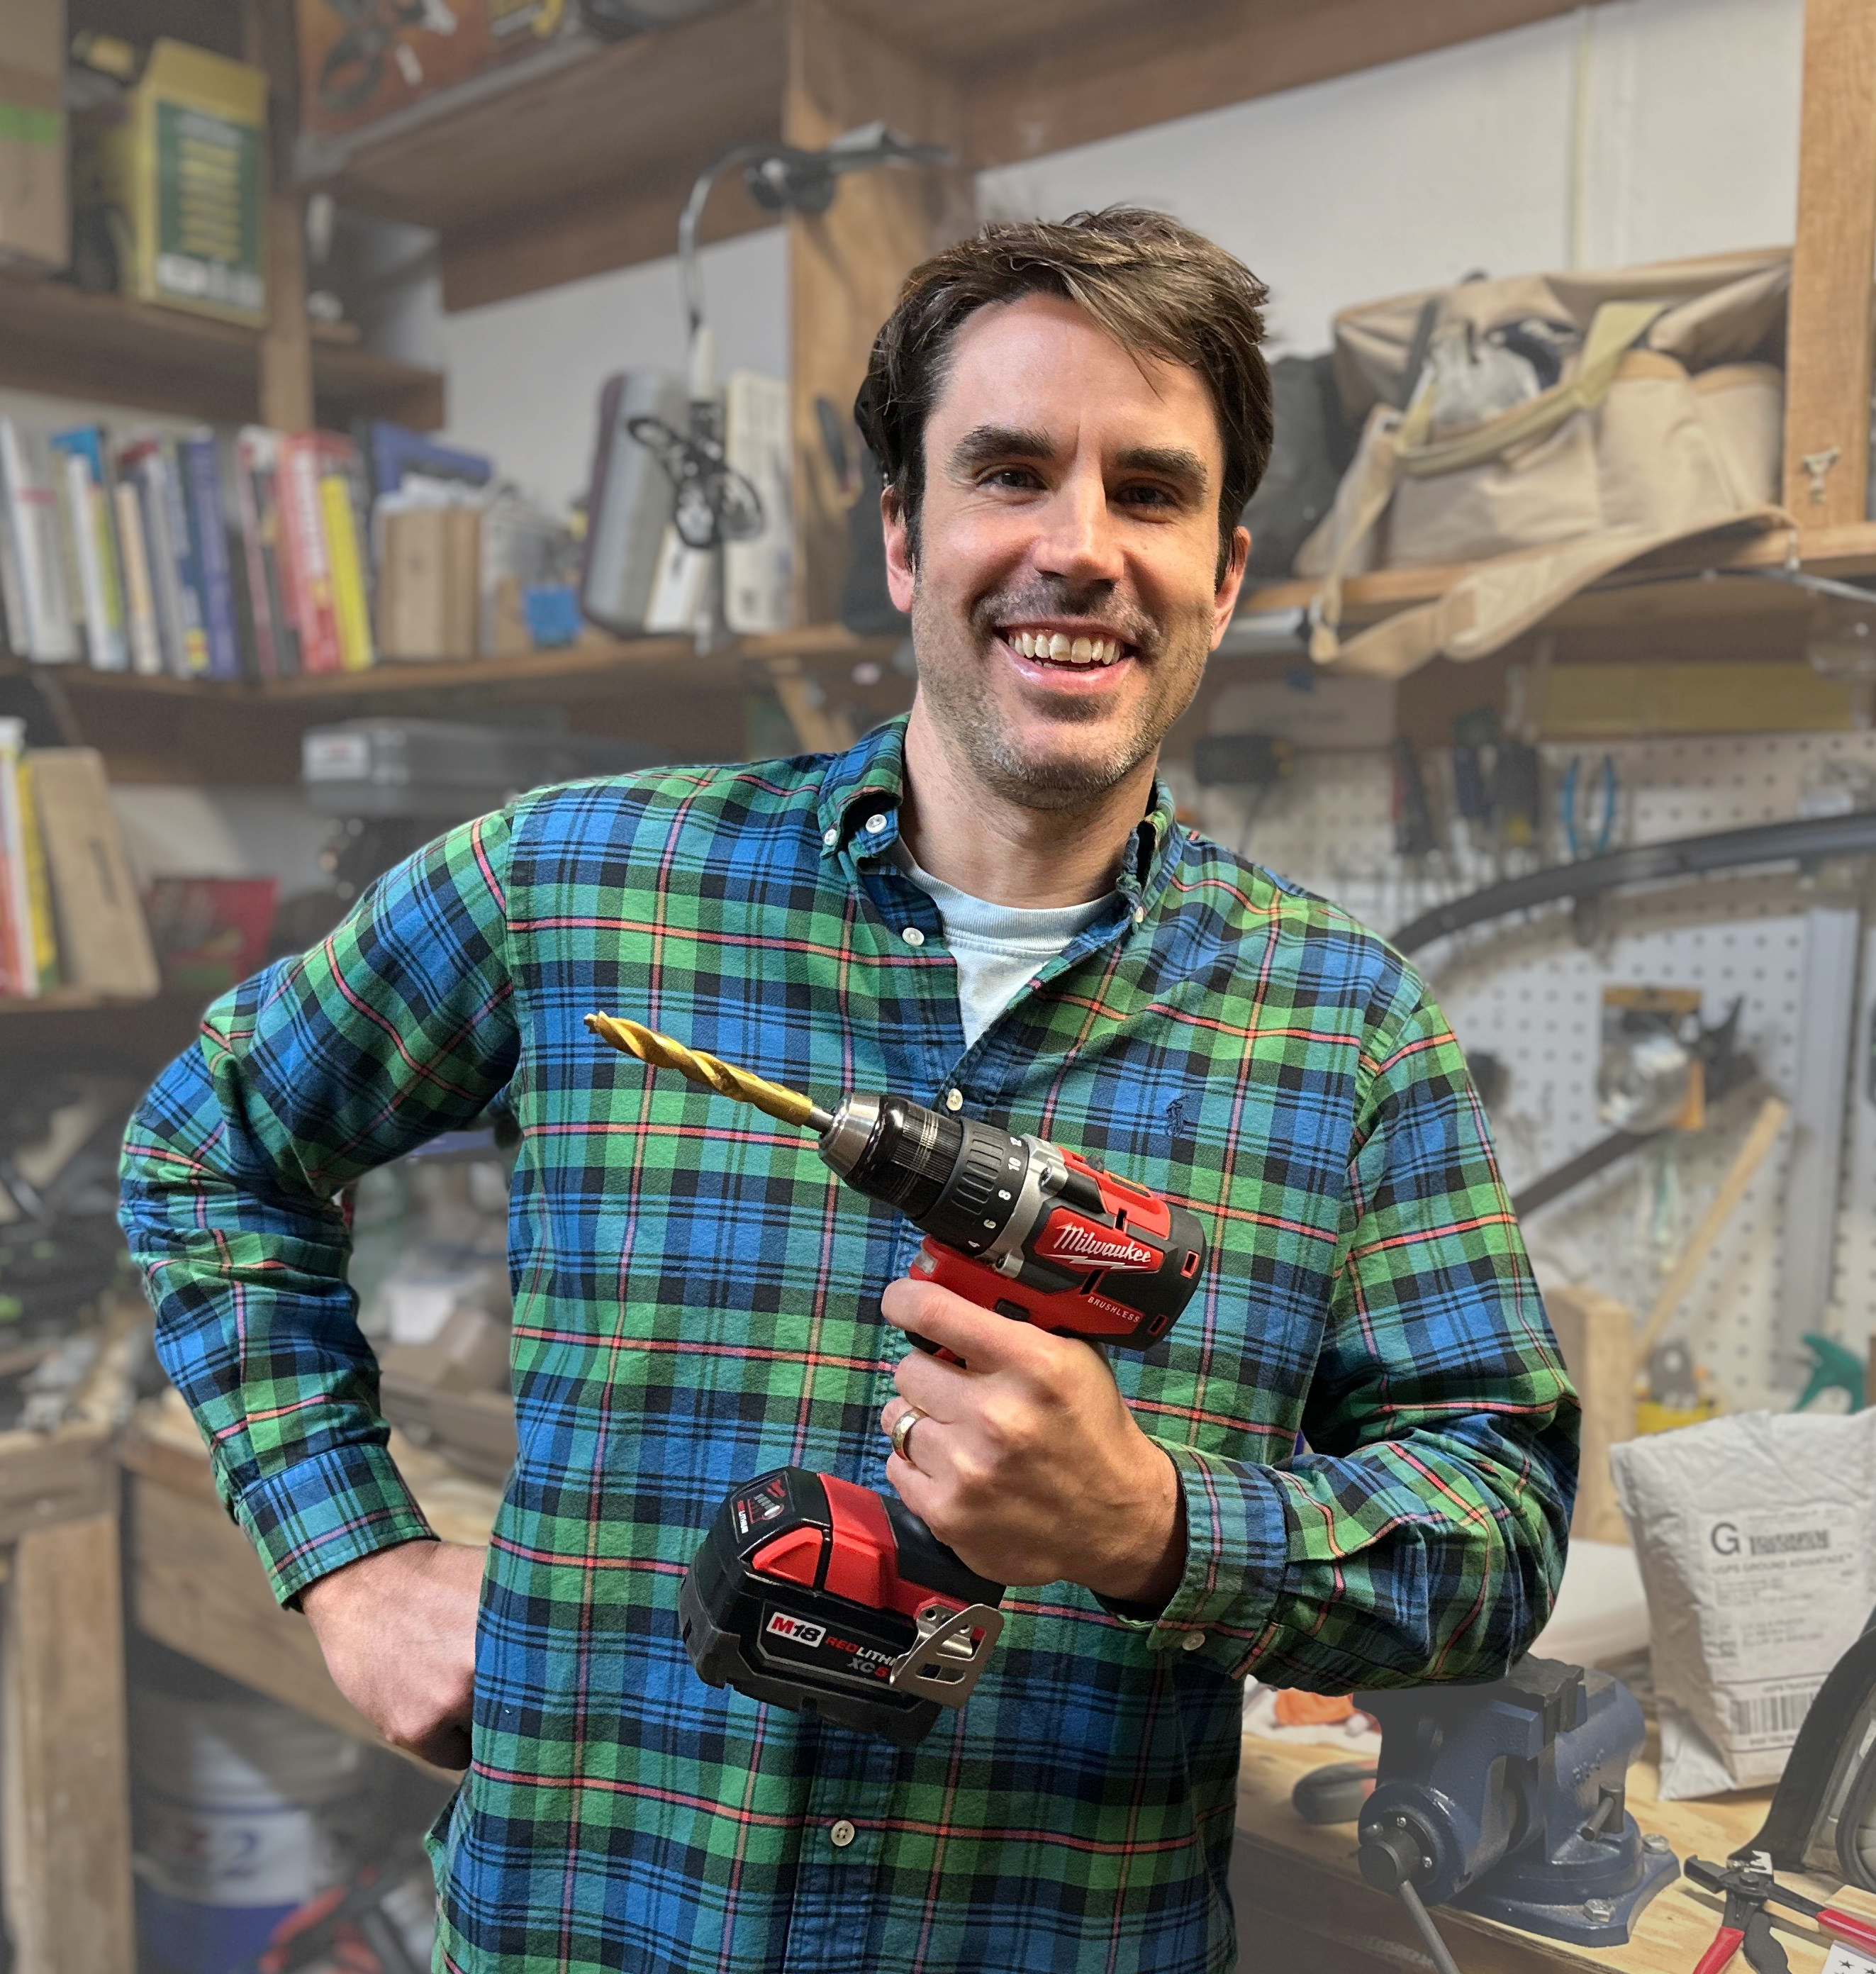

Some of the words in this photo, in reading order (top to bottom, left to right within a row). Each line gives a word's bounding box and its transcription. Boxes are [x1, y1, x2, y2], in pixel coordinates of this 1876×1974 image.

[1007, 1157, 1022, 1171] 10
[998, 1189, 1012, 1200] 8
[983, 1219, 996, 1229] 6
[1053, 1222, 1152, 1263] Milwaukee
[1087, 1295, 1141, 1323] BRUSHLESS
[1710, 1522, 1741, 1555] G
[771, 1616, 822, 1642] M18
